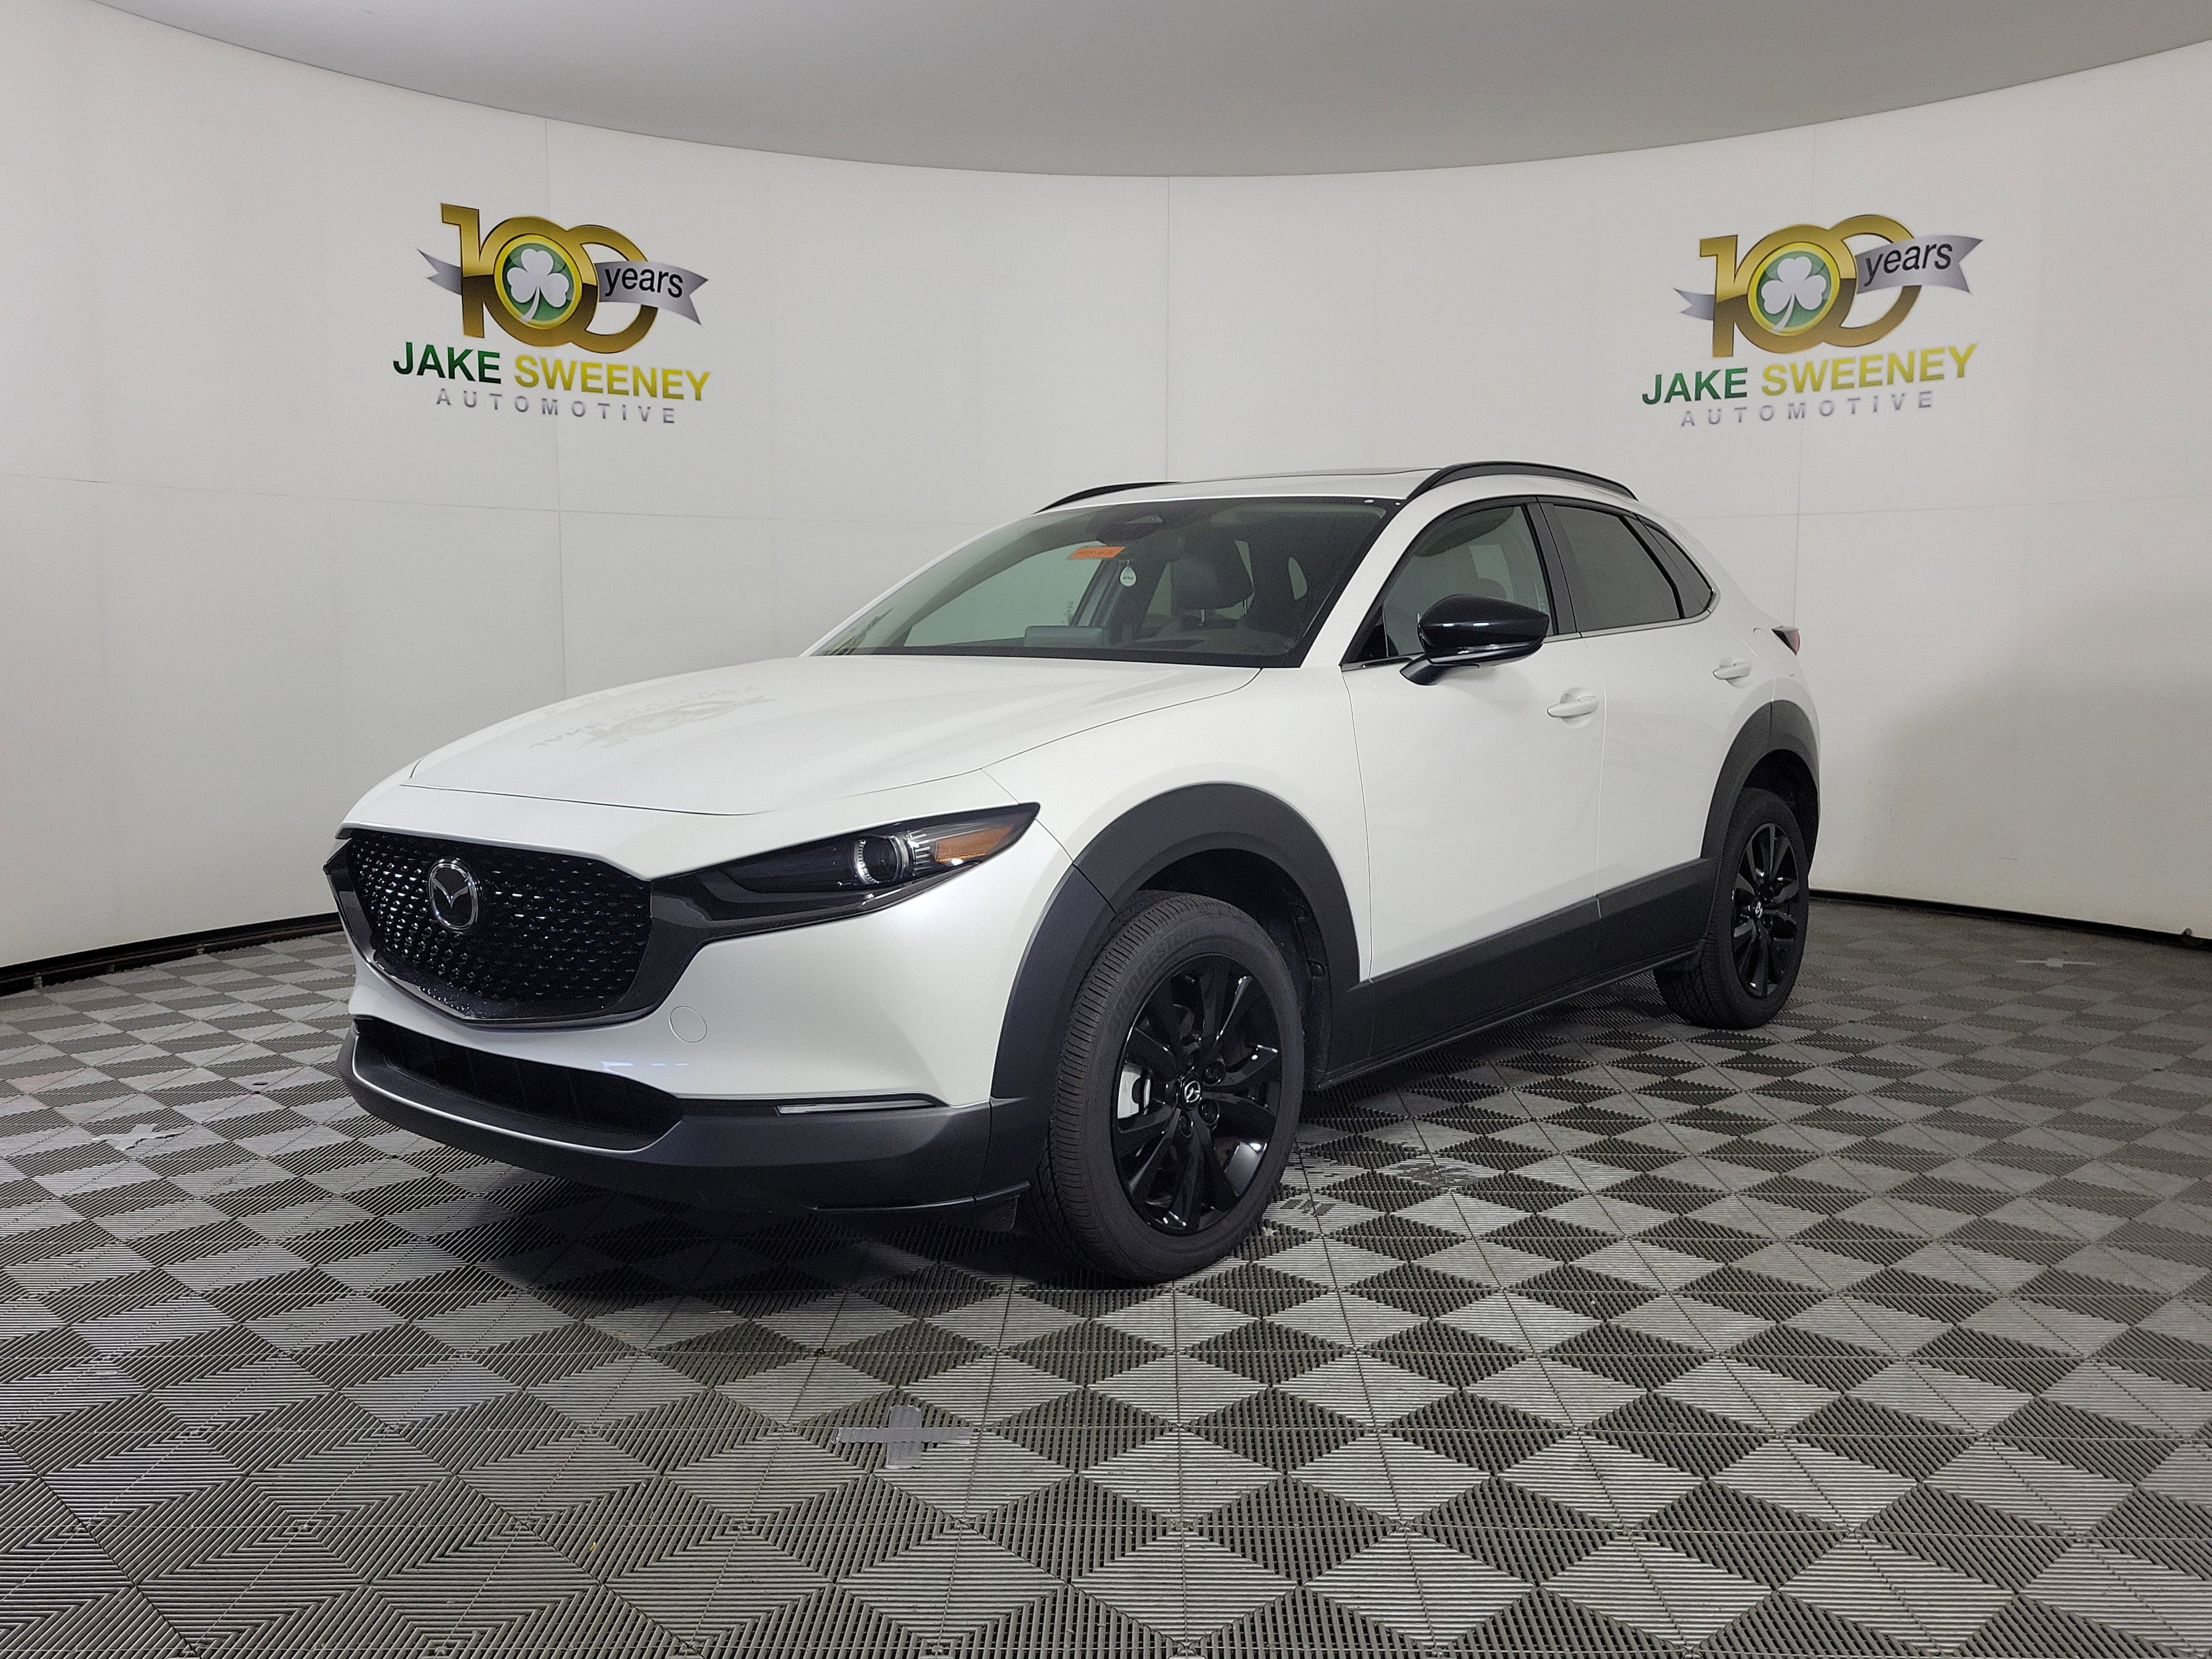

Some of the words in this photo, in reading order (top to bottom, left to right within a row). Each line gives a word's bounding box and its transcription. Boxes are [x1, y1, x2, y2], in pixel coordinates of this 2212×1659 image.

[440, 202, 659, 354] 100
[603, 267, 684, 297] years
[1700, 213, 1921, 357] 100
[1864, 244, 1953, 287] years
[393, 342, 502, 385] JAKE
[514, 354, 711, 402] SWEENEY
[1641, 368, 1748, 405] JAKE
[1760, 343, 1978, 397] SWEENEY
[436, 387, 676, 424] AUTOMOTIVE
[1680, 390, 1933, 427] AUTOMOTIVE
